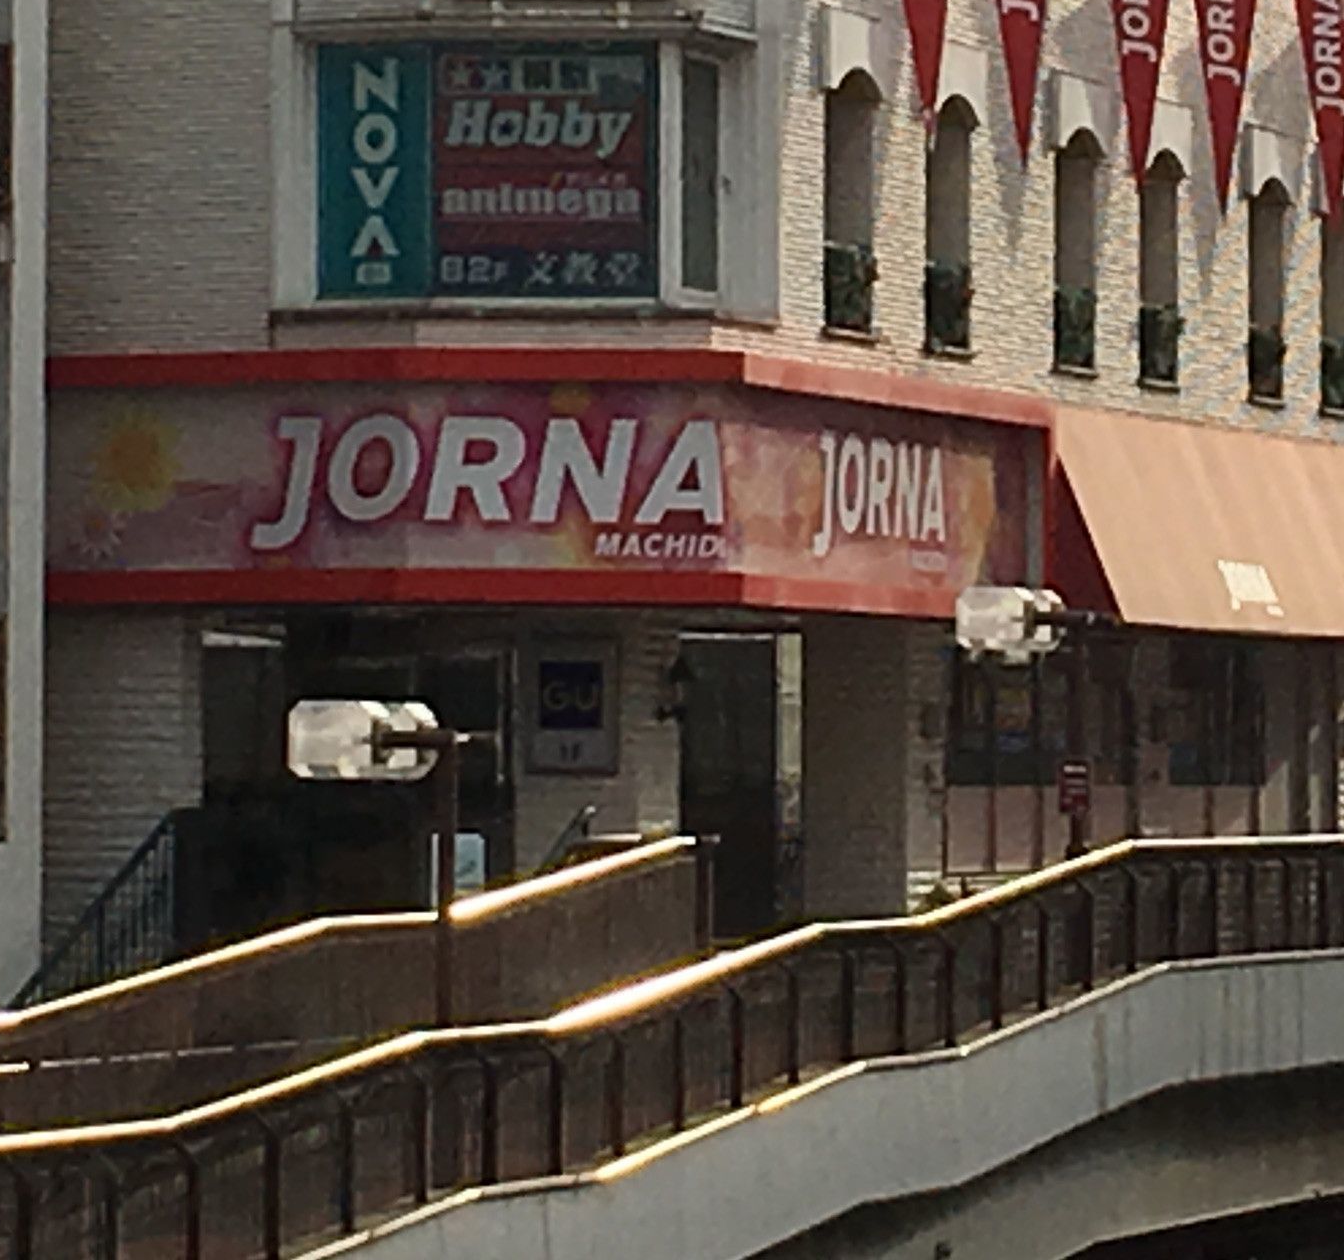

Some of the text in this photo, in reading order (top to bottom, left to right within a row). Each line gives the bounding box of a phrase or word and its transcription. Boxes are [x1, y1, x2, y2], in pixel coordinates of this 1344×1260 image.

[351, 57, 401, 258] NOVA
[445, 99, 633, 160] Hobby
[440, 183, 642, 222] animega
[250, 414, 724, 550] JORNA
[812, 430, 947, 558] JORNA
[543, 681, 599, 711] GU
